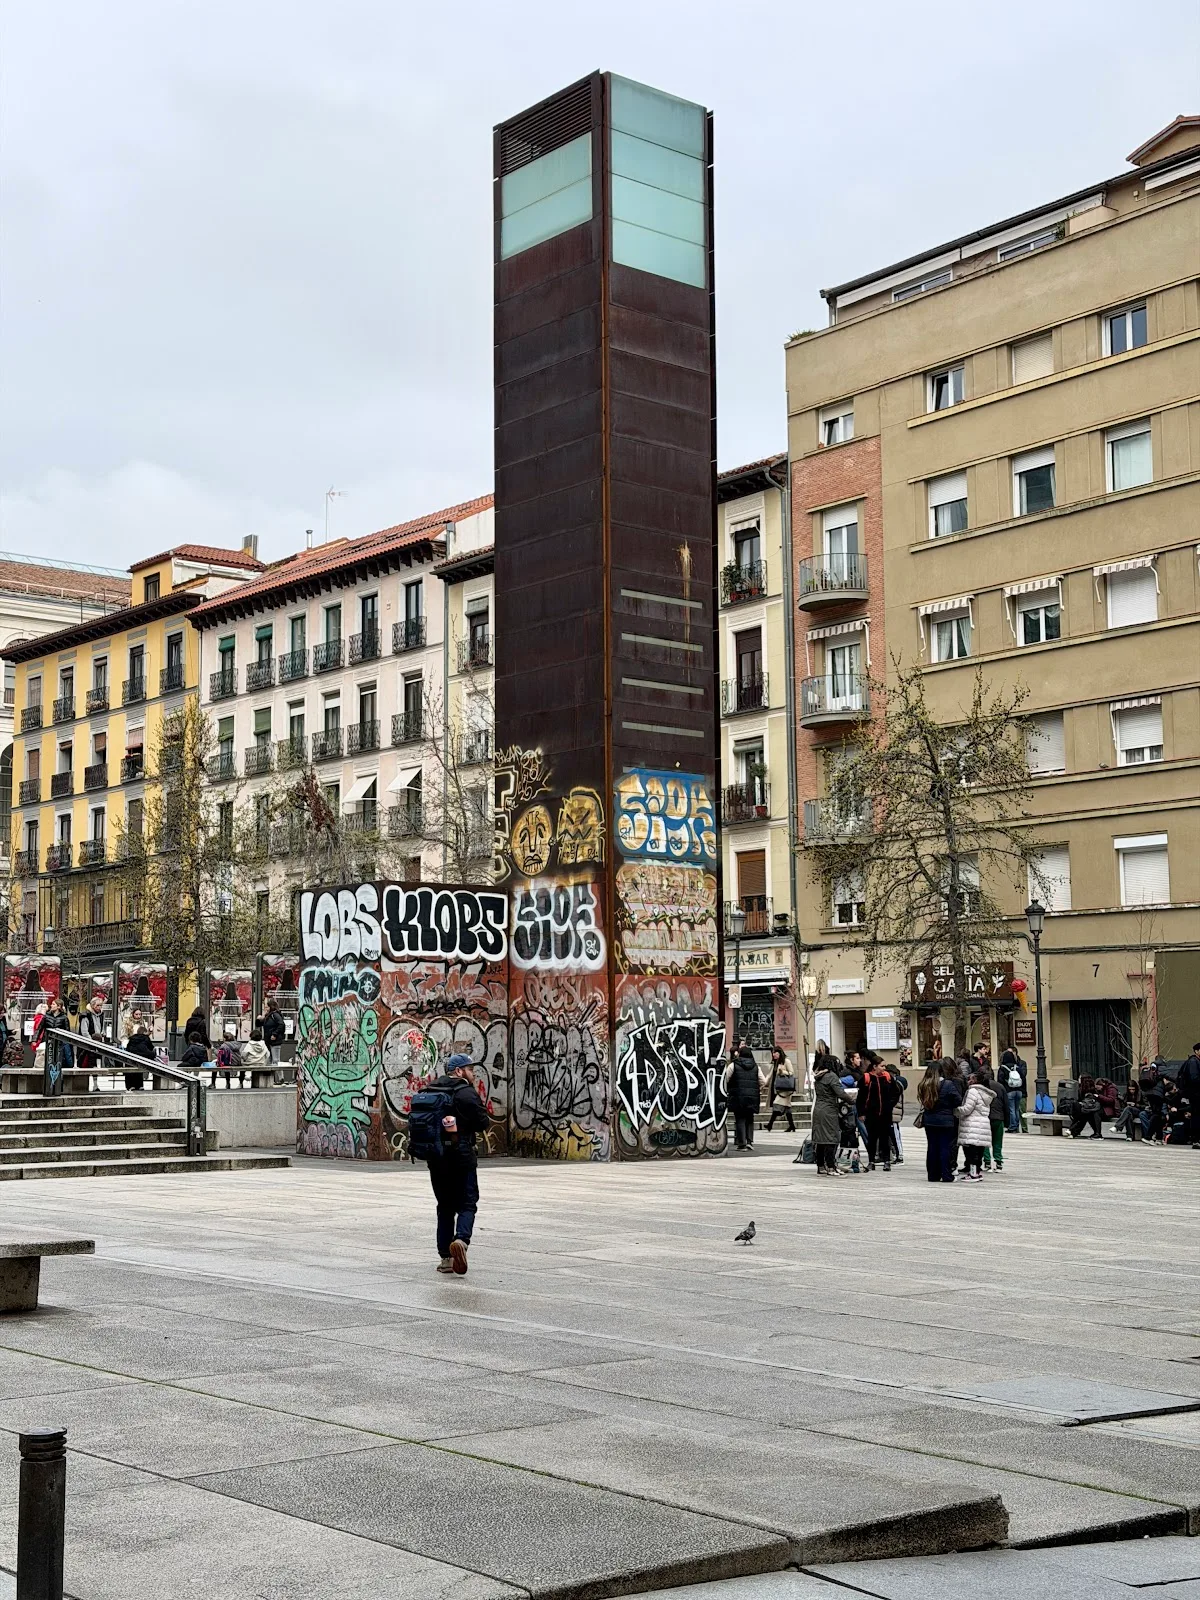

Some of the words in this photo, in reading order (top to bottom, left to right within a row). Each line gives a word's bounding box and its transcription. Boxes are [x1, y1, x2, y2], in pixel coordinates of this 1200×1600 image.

[301, 884, 382, 961] LOBS
[724, 953, 769, 967] IZZA-BAR
[932, 964, 986, 976] GELERIA
[1092, 964, 1100, 978] 7
[934, 975, 985, 993] GAÌA
